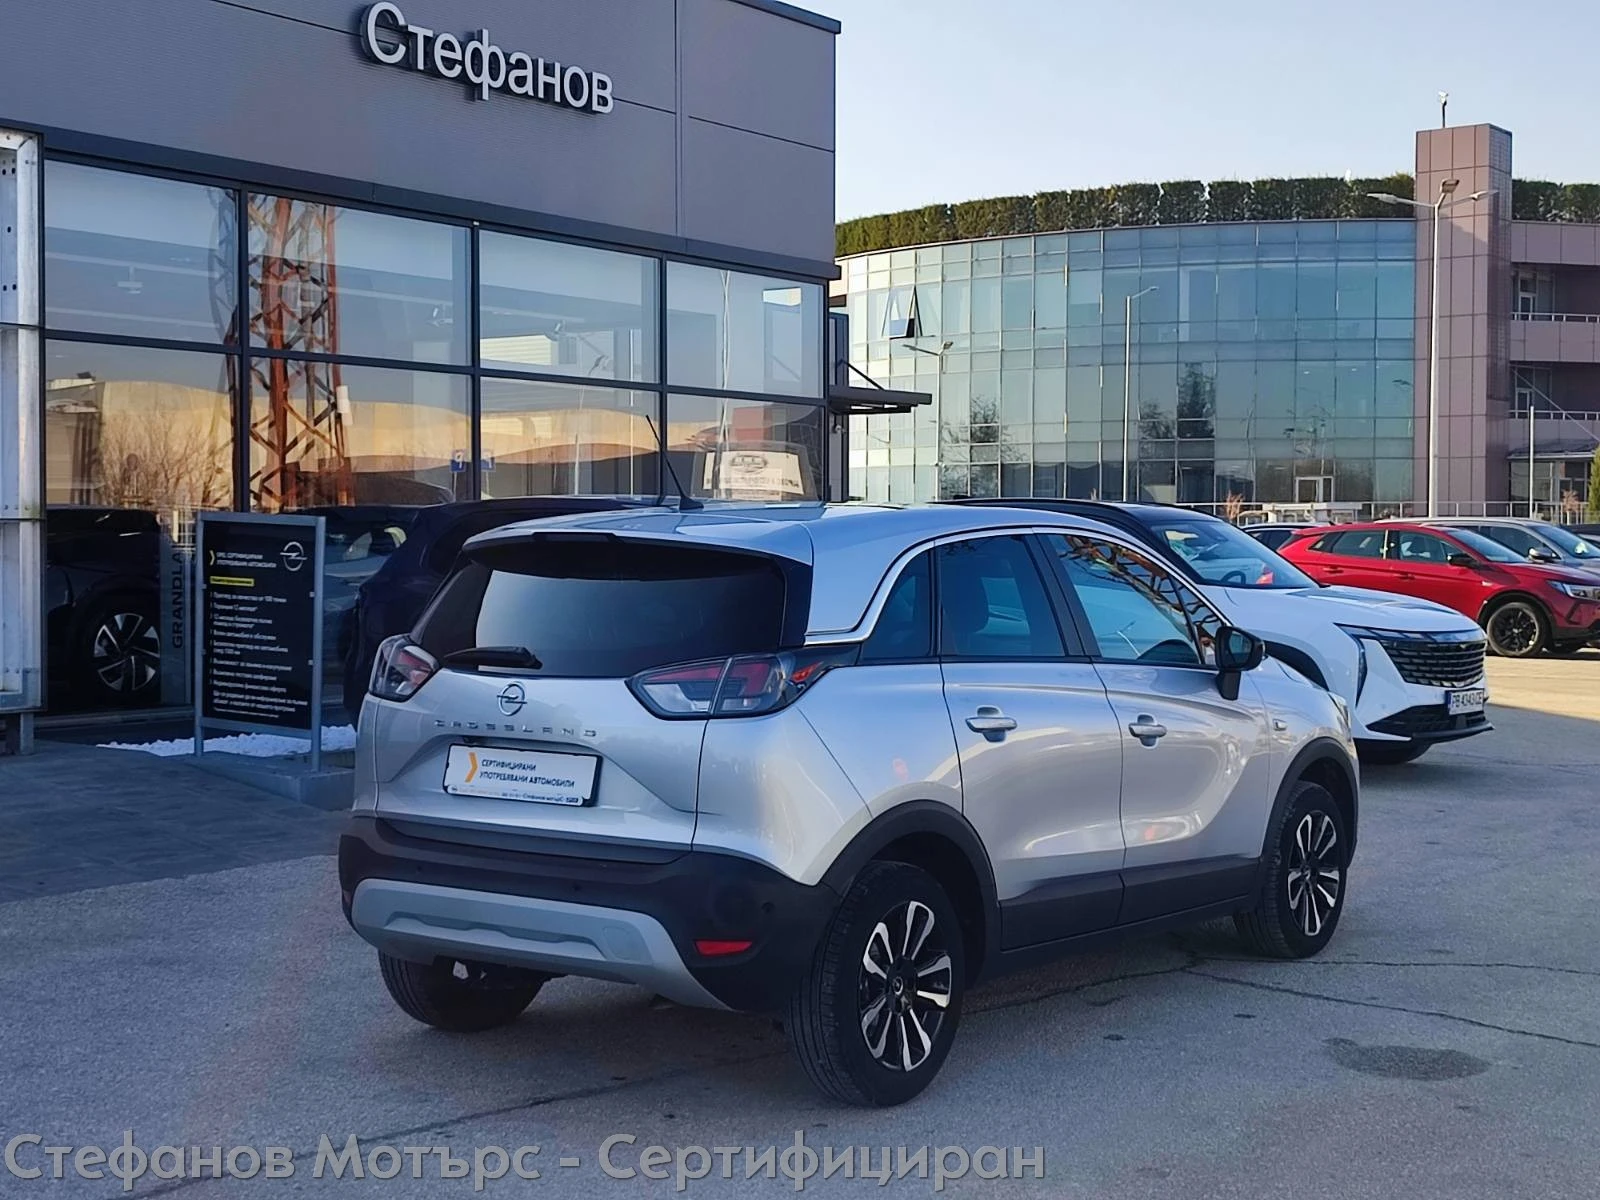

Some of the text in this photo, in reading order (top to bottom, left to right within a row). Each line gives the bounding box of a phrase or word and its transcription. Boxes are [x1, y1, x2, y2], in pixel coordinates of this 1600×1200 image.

[365, 1, 614, 114] Стефанов
[434, 719, 598, 738] CROSSLAND
[481, 758, 537, 772] СЕРТИФИЦИРАНИ
[479, 770, 576, 788] УПОТРЕБЯВАНИ АВТОМОБИЛИ
